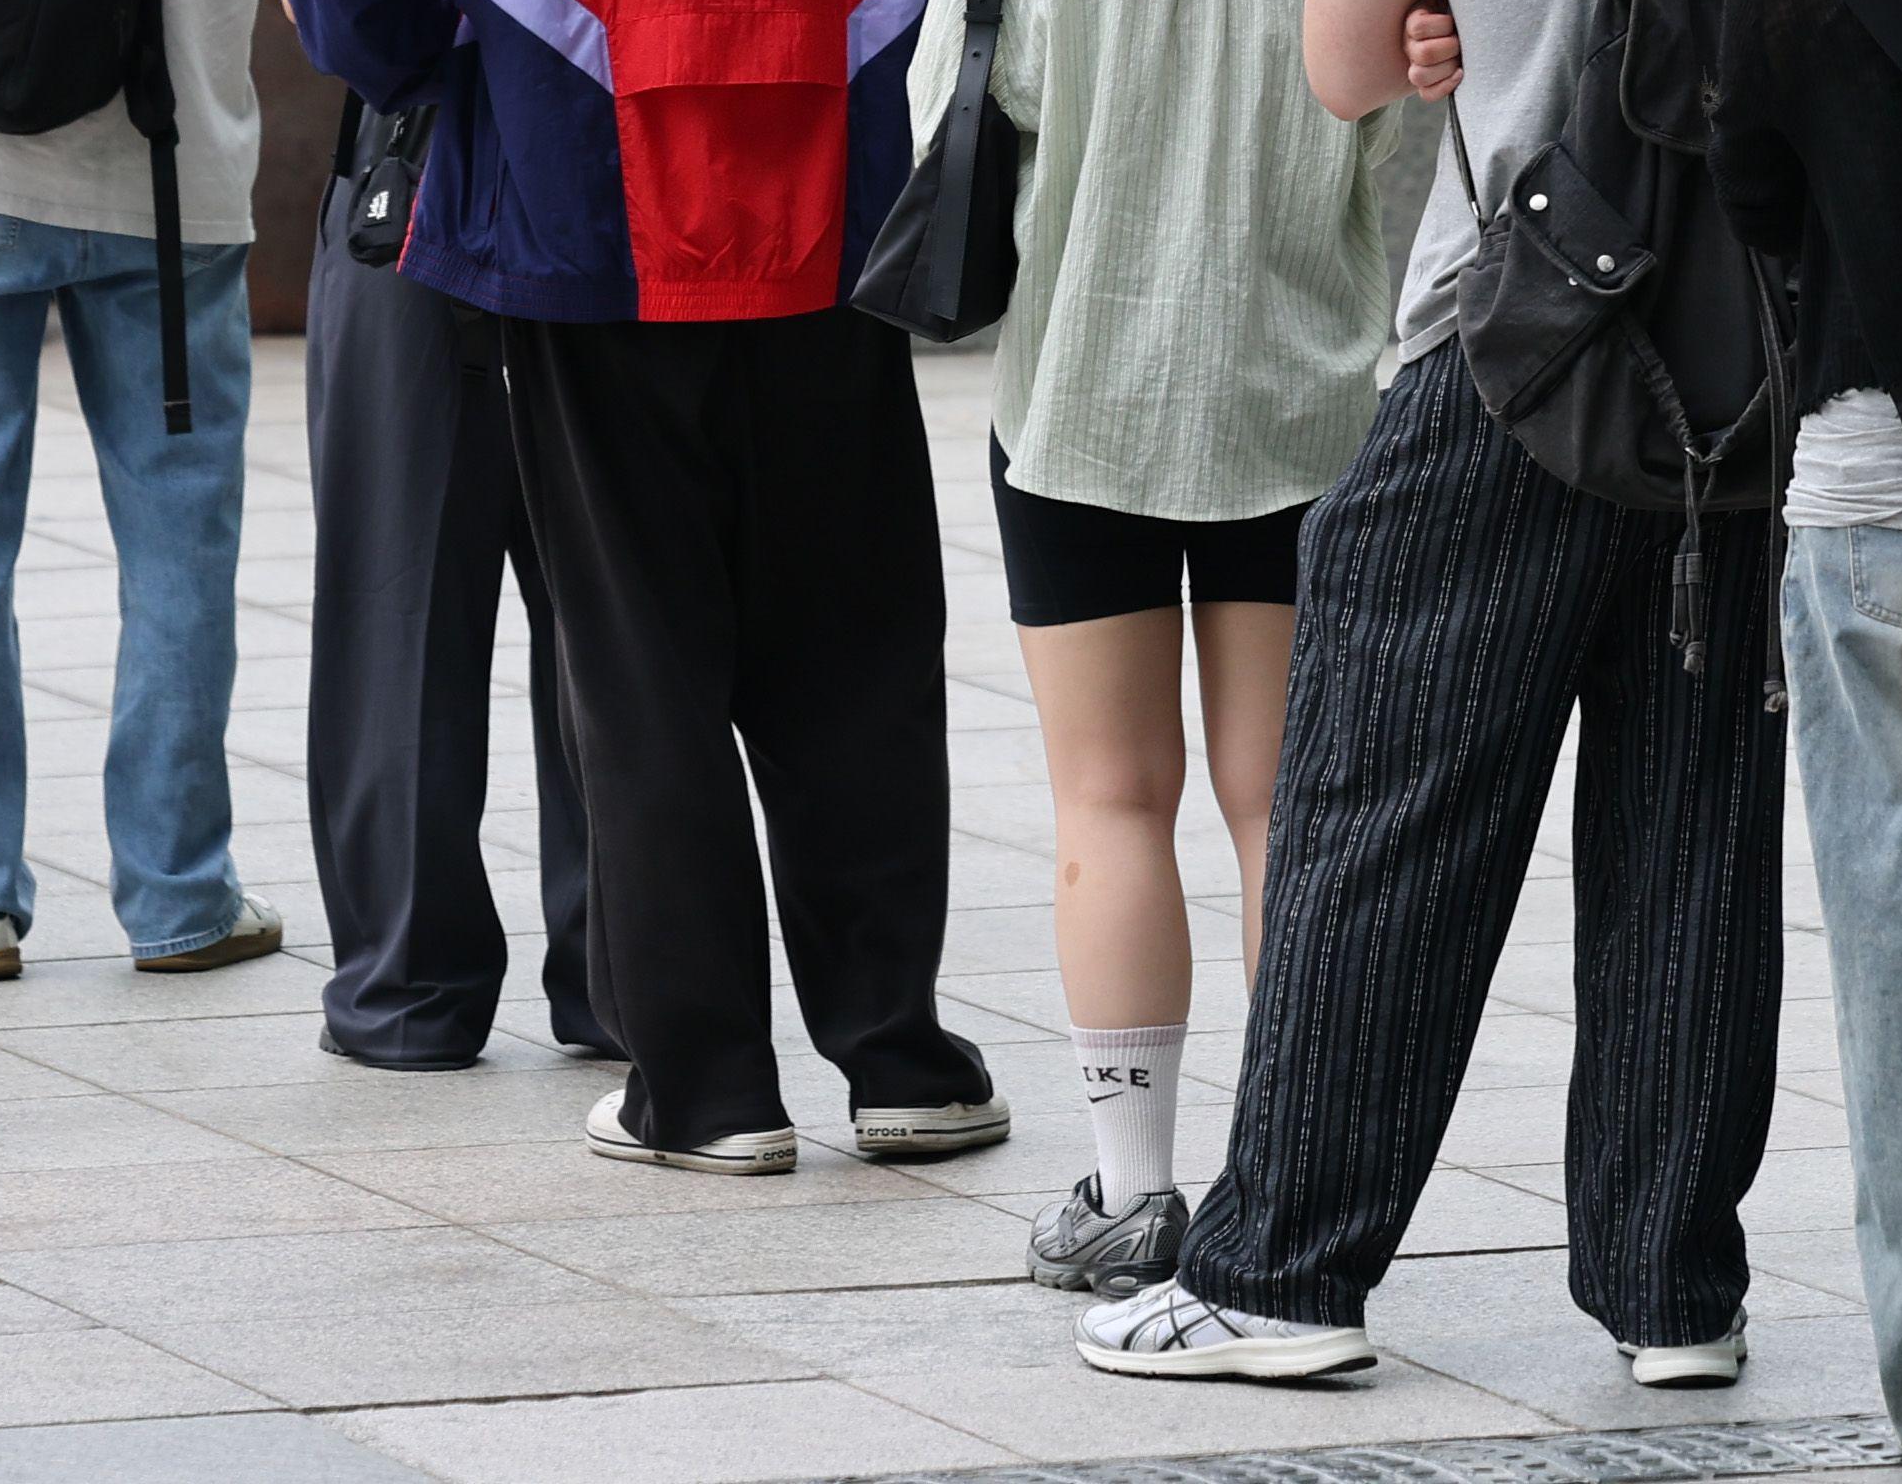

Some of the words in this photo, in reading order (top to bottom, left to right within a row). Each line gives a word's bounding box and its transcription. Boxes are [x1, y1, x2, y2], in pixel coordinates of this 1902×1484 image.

[1082, 1067, 1150, 1088] IKE
[867, 1126, 908, 1137] crocs
[763, 1147, 796, 1162] crocs
